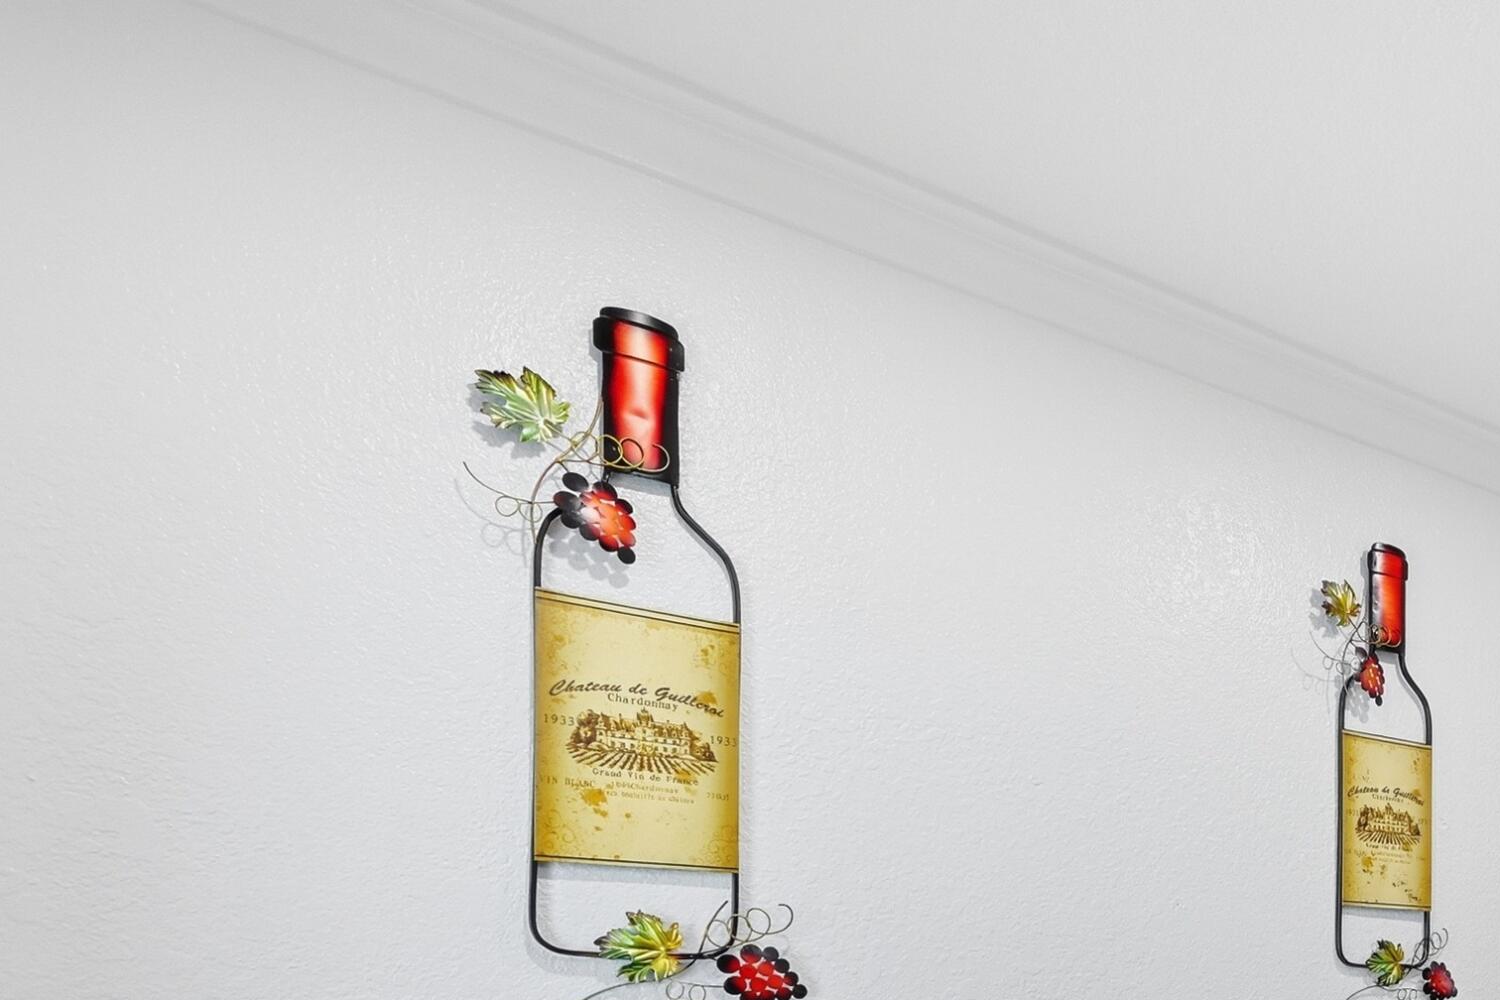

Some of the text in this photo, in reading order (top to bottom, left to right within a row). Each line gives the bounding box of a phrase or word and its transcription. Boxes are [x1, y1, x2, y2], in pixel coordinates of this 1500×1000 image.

[548, 679, 622, 697] Chateau
[628, 683, 648, 695] de
[607, 693, 679, 712] Chardonnay
[543, 713, 575, 727] 1933
[592, 768, 622, 778] Grand
[628, 772, 645, 781] Vin
